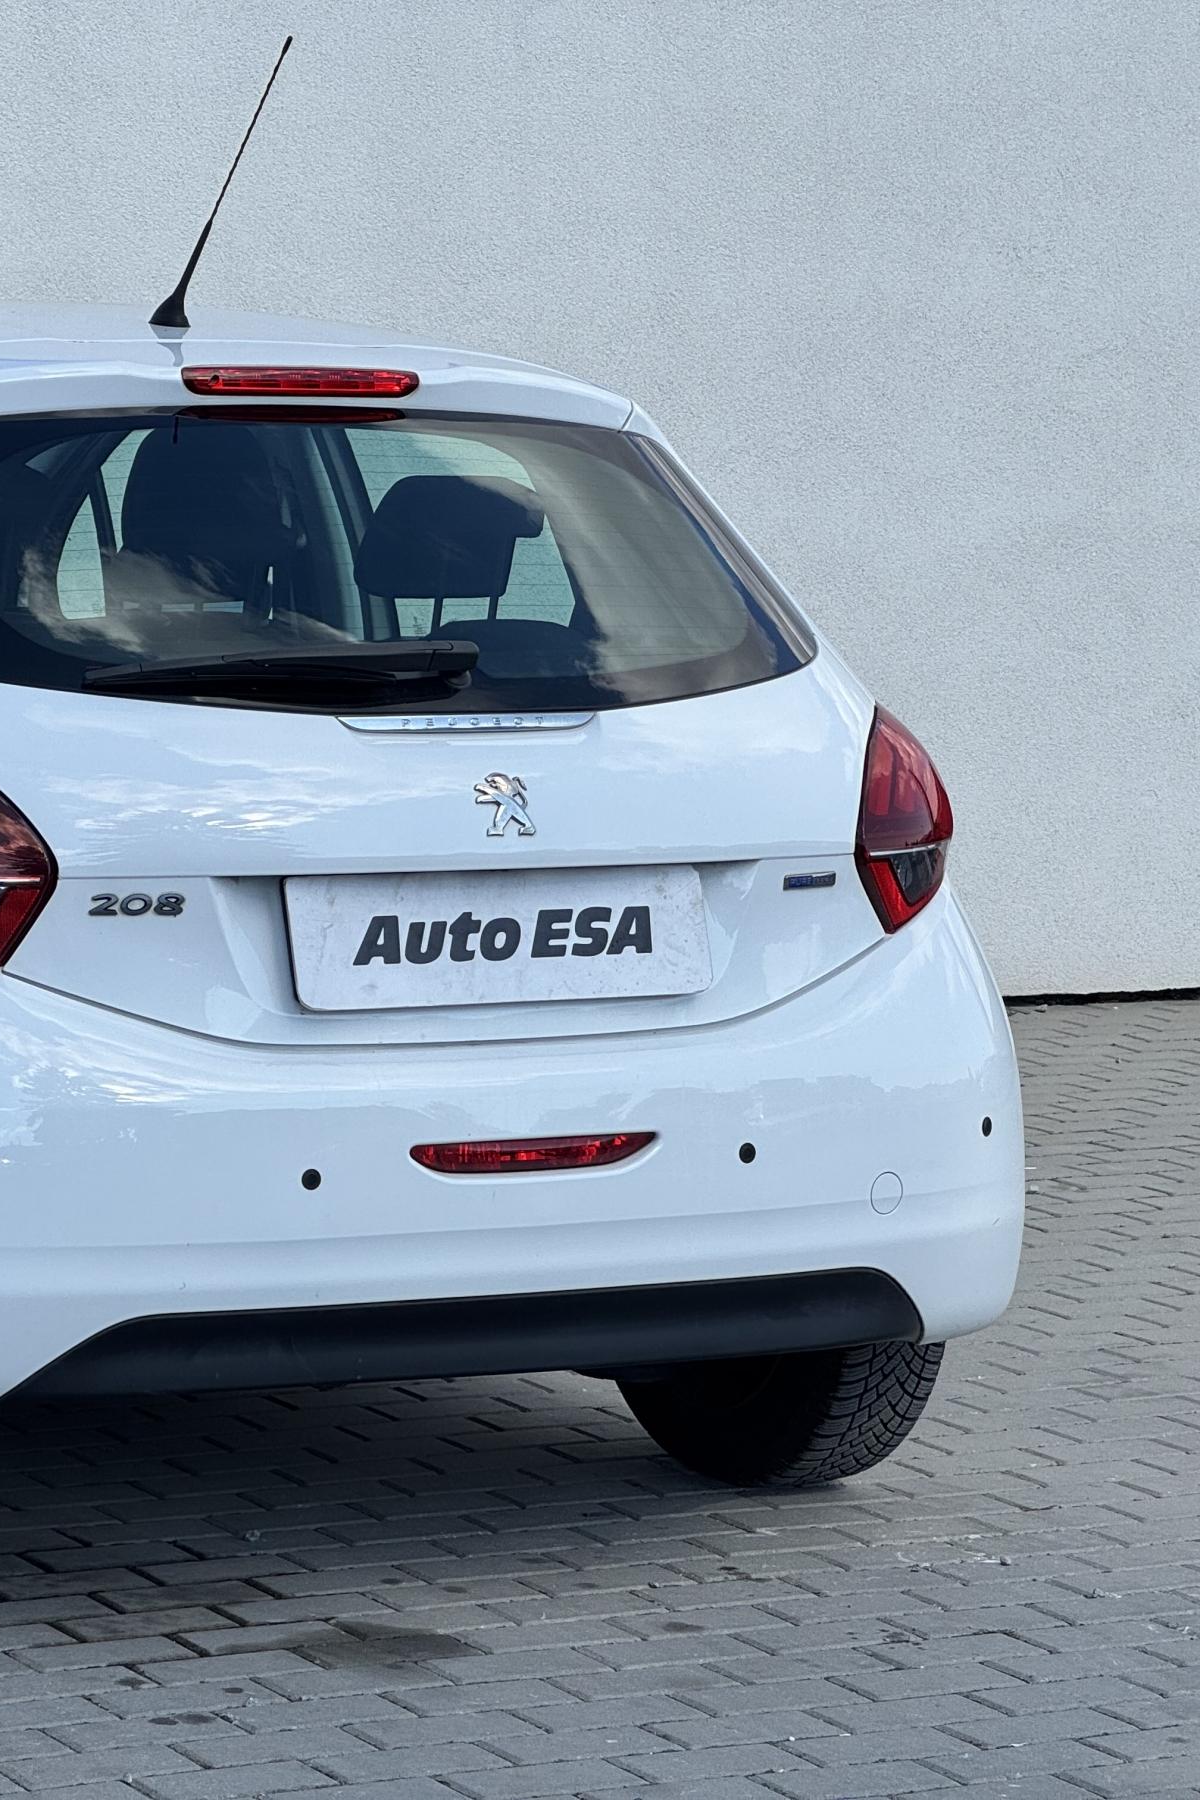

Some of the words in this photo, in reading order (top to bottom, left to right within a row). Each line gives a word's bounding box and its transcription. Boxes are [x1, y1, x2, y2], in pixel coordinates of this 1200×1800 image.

[401, 716, 544, 728] PEUGEOT
[88, 893, 185, 917] 208
[353, 912, 521, 965] Auto
[531, 906, 652, 958] ESA
